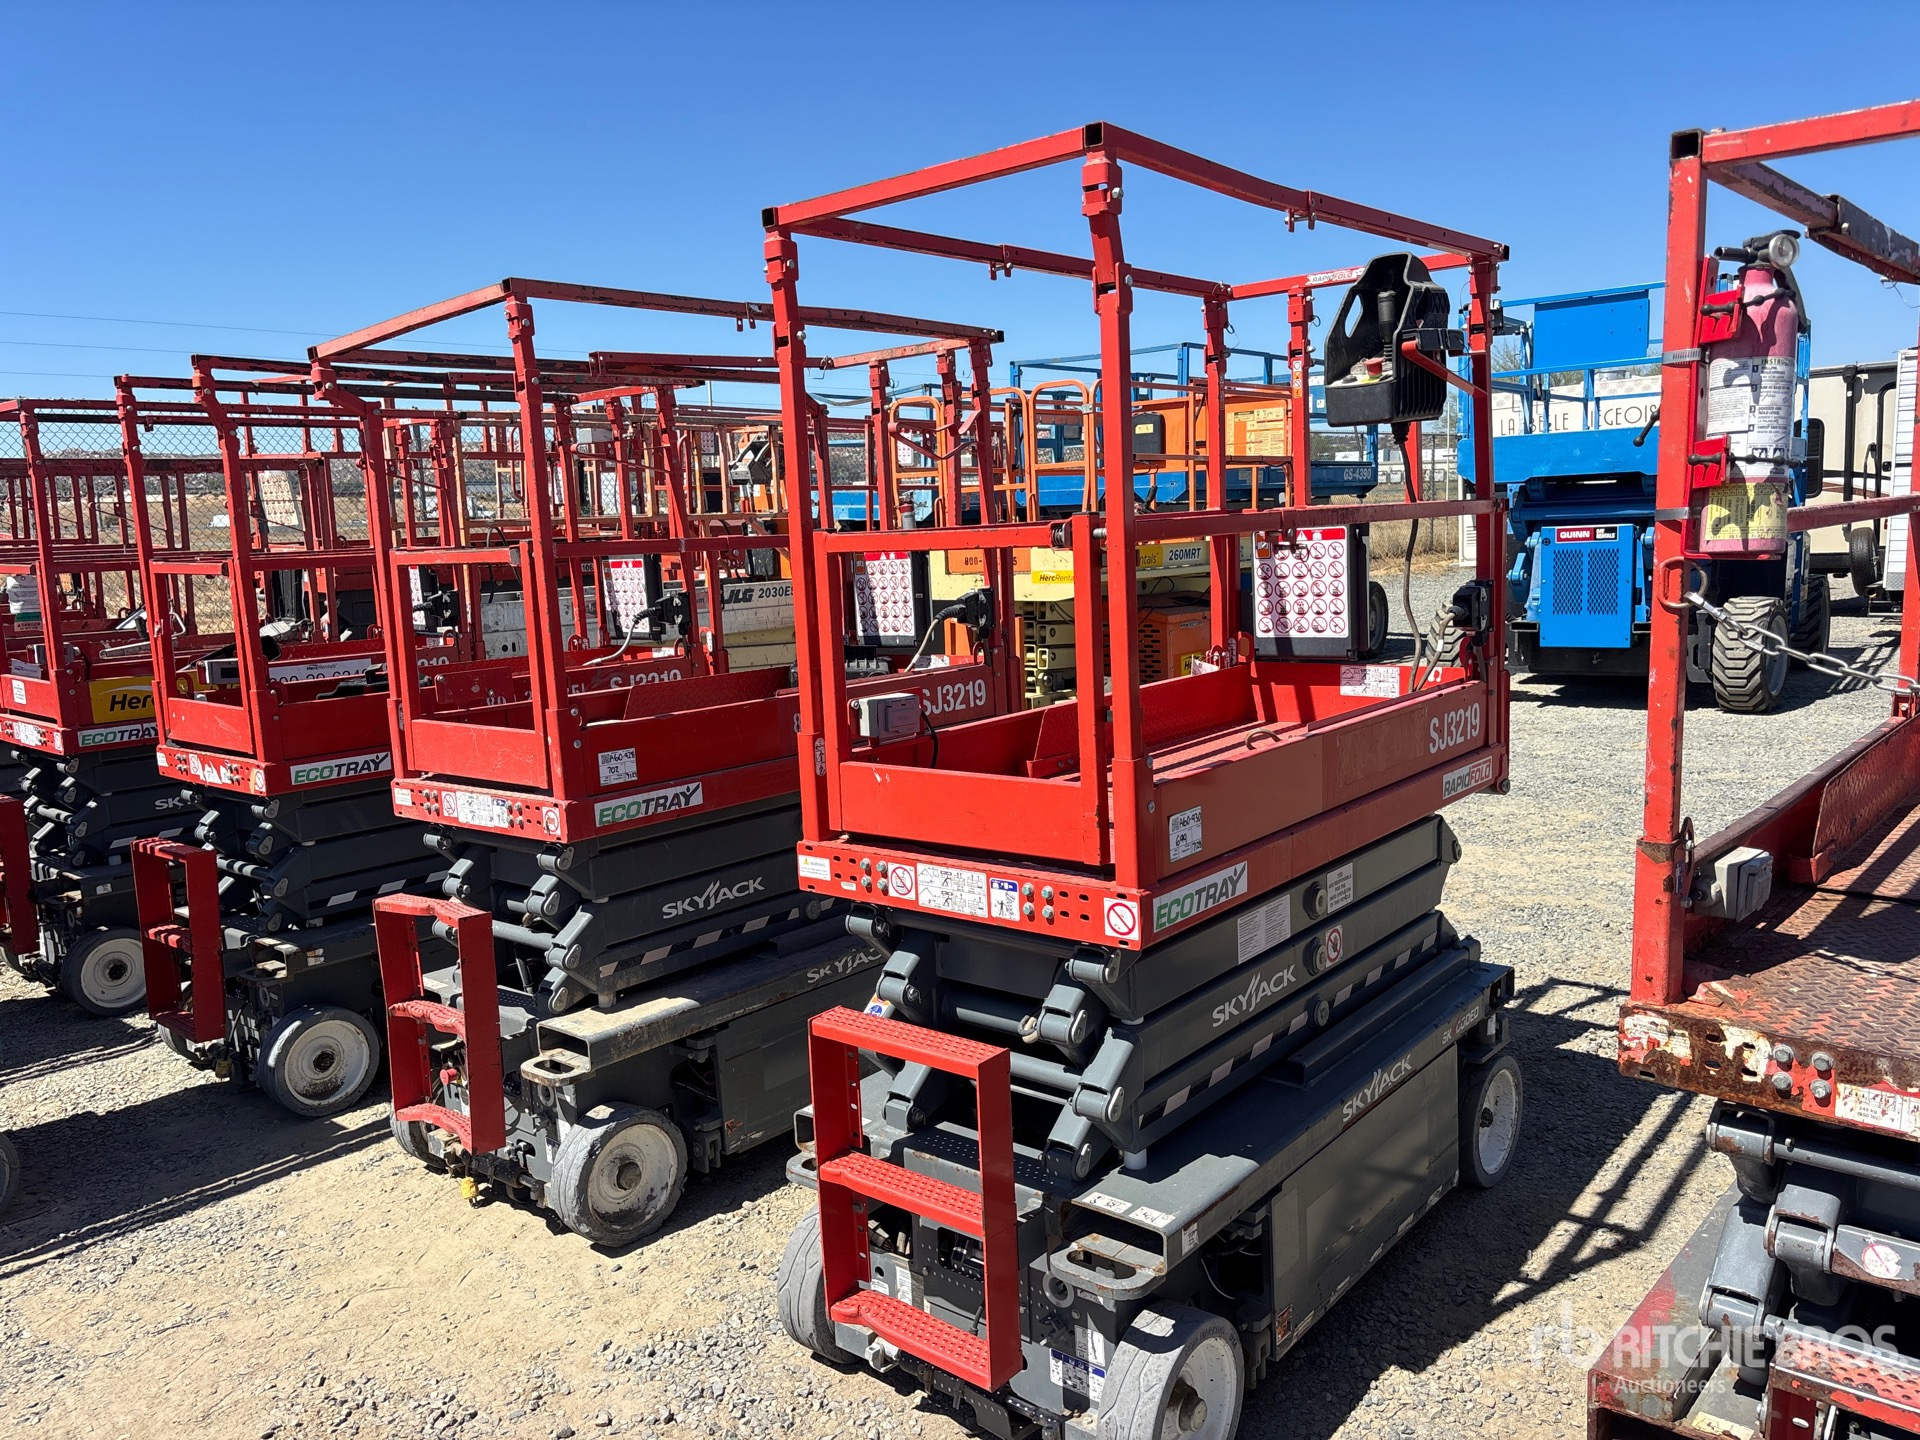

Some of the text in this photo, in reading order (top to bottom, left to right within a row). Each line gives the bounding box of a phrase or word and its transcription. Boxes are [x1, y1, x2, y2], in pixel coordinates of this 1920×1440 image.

[1501, 418, 1515, 435] LA
[1344, 468, 1372, 480] GS-4390
[1560, 530, 1590, 539] QUINN
[1168, 547, 1202, 561] 260MRT
[722, 588, 755, 604] JLG
[922, 678, 986, 716] SJ3219
[1429, 702, 1480, 754] SJ3219
[293, 752, 389, 784] ECOTRAY
[607, 765, 620, 774] 702
[1444, 761, 1491, 798] RAPIDFOLD
[598, 782, 700, 826] ECOTRAY
[662, 876, 766, 919] SKYJACK
[1155, 862, 1246, 931] ECOTRAY
[1212, 964, 1297, 1028] SKYJACK
[1342, 1053, 1413, 1123] SKYJACK
